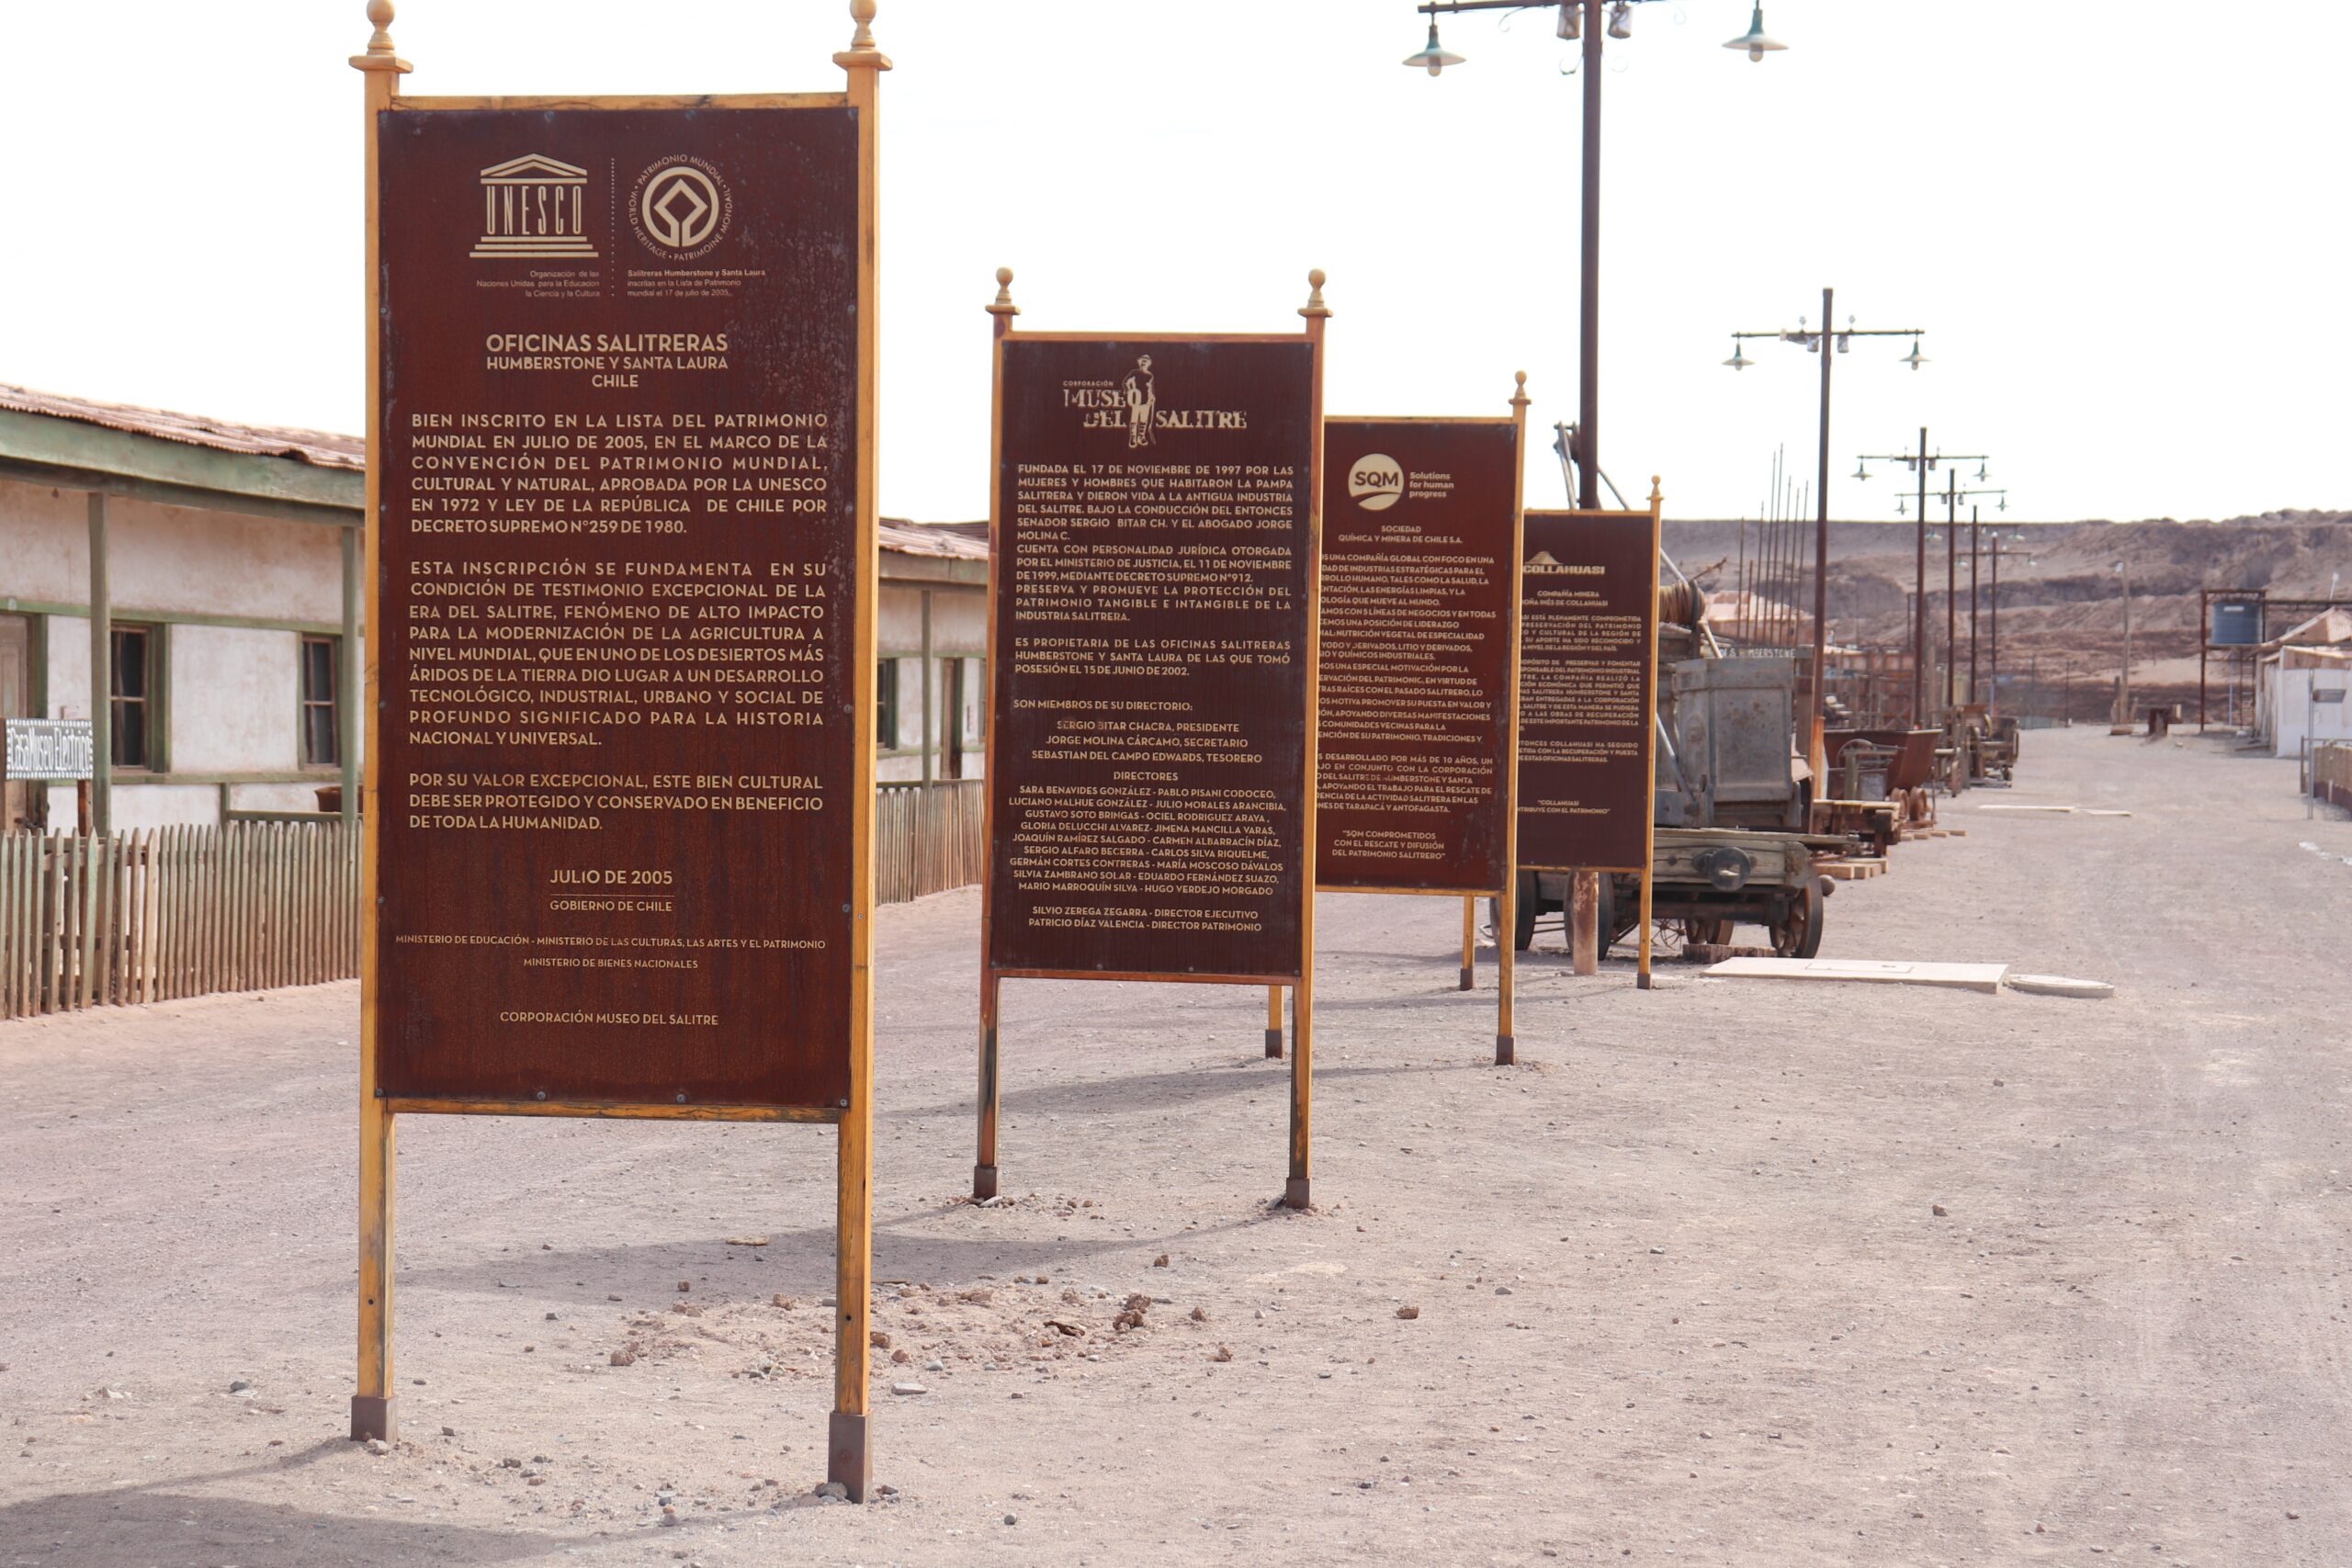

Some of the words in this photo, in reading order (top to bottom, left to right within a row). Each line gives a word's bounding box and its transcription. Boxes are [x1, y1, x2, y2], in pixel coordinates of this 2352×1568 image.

[638, 153, 687, 186] PATRIMONIO
[690, 155, 724, 186] MUNDIAL
[486, 185, 582, 235] UNESCO
[628, 190, 639, 224] WORLD
[673, 232, 724, 262] PATRIMOINE
[719, 187, 733, 234] MONDIAL
[633, 225, 668, 259] HERITAGE
[486, 333, 591, 351] OFICINAS
[596, 333, 728, 351] SALITRERAS
[486, 356, 605, 369] HUMBERSTONE
[608, 356, 618, 368] Y
[623, 356, 673, 368] SANTA
[676, 355, 728, 368] LAURA
[592, 374, 638, 387] CHILE
[1063, 388, 1142, 409] MUSEO
[412, 413, 452, 426] BIEN
[461, 413, 545, 427] INSCRITO
[554, 414, 576, 427] EN
[585, 414, 606, 427] LA
[616, 414, 662, 427] LISTA
[673, 414, 706, 427] DEL
[714, 413, 828, 426] PATRIMONIO
[1083, 410, 1126, 428] DEL
[1156, 410, 1248, 429] SALITRE
[412, 454, 544, 469] CONVENCIÓN
[555, 457, 590, 469] DEL
[600, 457, 722, 469] PATRIMONIO
[732, 456, 827, 469] MUNDIAL,
[1017, 464, 1069, 473] FUNDADA
[1073, 464, 1086, 473] EL
[1091, 464, 1103, 473] 17
[1108, 465, 1122, 473] DE
[1127, 465, 1191, 474] NOVIEMBRE
[1195, 465, 1209, 474] DE
[1215, 465, 1240, 474] 1997
[1246, 466, 1268, 474] POR
[1273, 466, 1294, 475] LAS
[1409, 471, 1450, 479] Solutions
[1354, 471, 1399, 488] SQM
[1409, 479, 1421, 488] for
[1423, 480, 1453, 489] human
[1408, 491, 1446, 499] progress
[411, 519, 487, 532] DECRETO
[489, 519, 568, 533] SUPREMO
[620, 520, 641, 533] DE
[645, 520, 686, 533] 1980.
[1338, 533, 1373, 541] QUÍMICA
[1522, 565, 1604, 573] COLLAHUASI
[1015, 610, 1069, 620] INDUSTRIA
[1071, 611, 1129, 621] SALITRERA.
[1012, 699, 1035, 708] SON
[1037, 699, 1092, 708] MIEMBROS
[1094, 700, 1108, 709] DE
[1111, 701, 1124, 709] SU
[1125, 701, 1193, 710] DIRECTORIO:
[409, 710, 510, 723] PROFUNDO
[519, 710, 640, 724] SIGNIFICADO
[650, 711, 695, 724] PARA
[706, 712, 727, 724] LA
[736, 712, 822, 725] HISTORIA
[409, 731, 492, 744] NACIONAL
[495, 731, 506, 744] Y
[509, 731, 601, 745] UNIVERSAL.
[1046, 735, 1080, 744] JORGE
[1082, 736, 1124, 745] MOLINA
[1126, 735, 1182, 746] CÁRCAMO,
[1183, 738, 1248, 747] SECRETARIO
[10, 728, 28, 771] Casa
[28, 728, 53, 771] Museo
[1032, 750, 1087, 759] SEBASTIAN
[1089, 750, 1109, 760] DEL
[1111, 751, 1149, 761] CAMPO
[1152, 752, 1204, 761] EDWARDS,
[1205, 753, 1261, 762] TESORERO
[1113, 771, 1178, 780] DIRECTORES
[1364, 830, 1436, 839] COMPROMETIDOS
[1363, 840, 1398, 848] RESCATE
[1407, 840, 1444, 850] DIFUSIÓN
[1348, 850, 1397, 858] PATRIMONIO
[549, 870, 600, 883] JULIO
[605, 870, 627, 884] DE
[630, 870, 672, 884] 2005
[549, 900, 615, 910] GOBIERNO
[617, 900, 633, 910] DE
[636, 901, 672, 911] CHILE
[1032, 906, 1062, 914] SILVIO
[1064, 907, 1101, 915] ZEREGA
[1103, 907, 1147, 916] ZEGARRA
[1154, 908, 1202, 917] DIRECTOR
[1204, 909, 1258, 919] EJECUTIVO
[523, 957, 580, 966] MINISTERIO
[582, 958, 595, 966] DE
[597, 958, 632, 967] BIENES
[634, 959, 697, 968] NACIONALES
[500, 1010, 593, 1022] CORPORACIÓN
[595, 1013, 639, 1023] MUSEO
[642, 1013, 666, 1024] DEL
[669, 1014, 718, 1025] SALITRE
